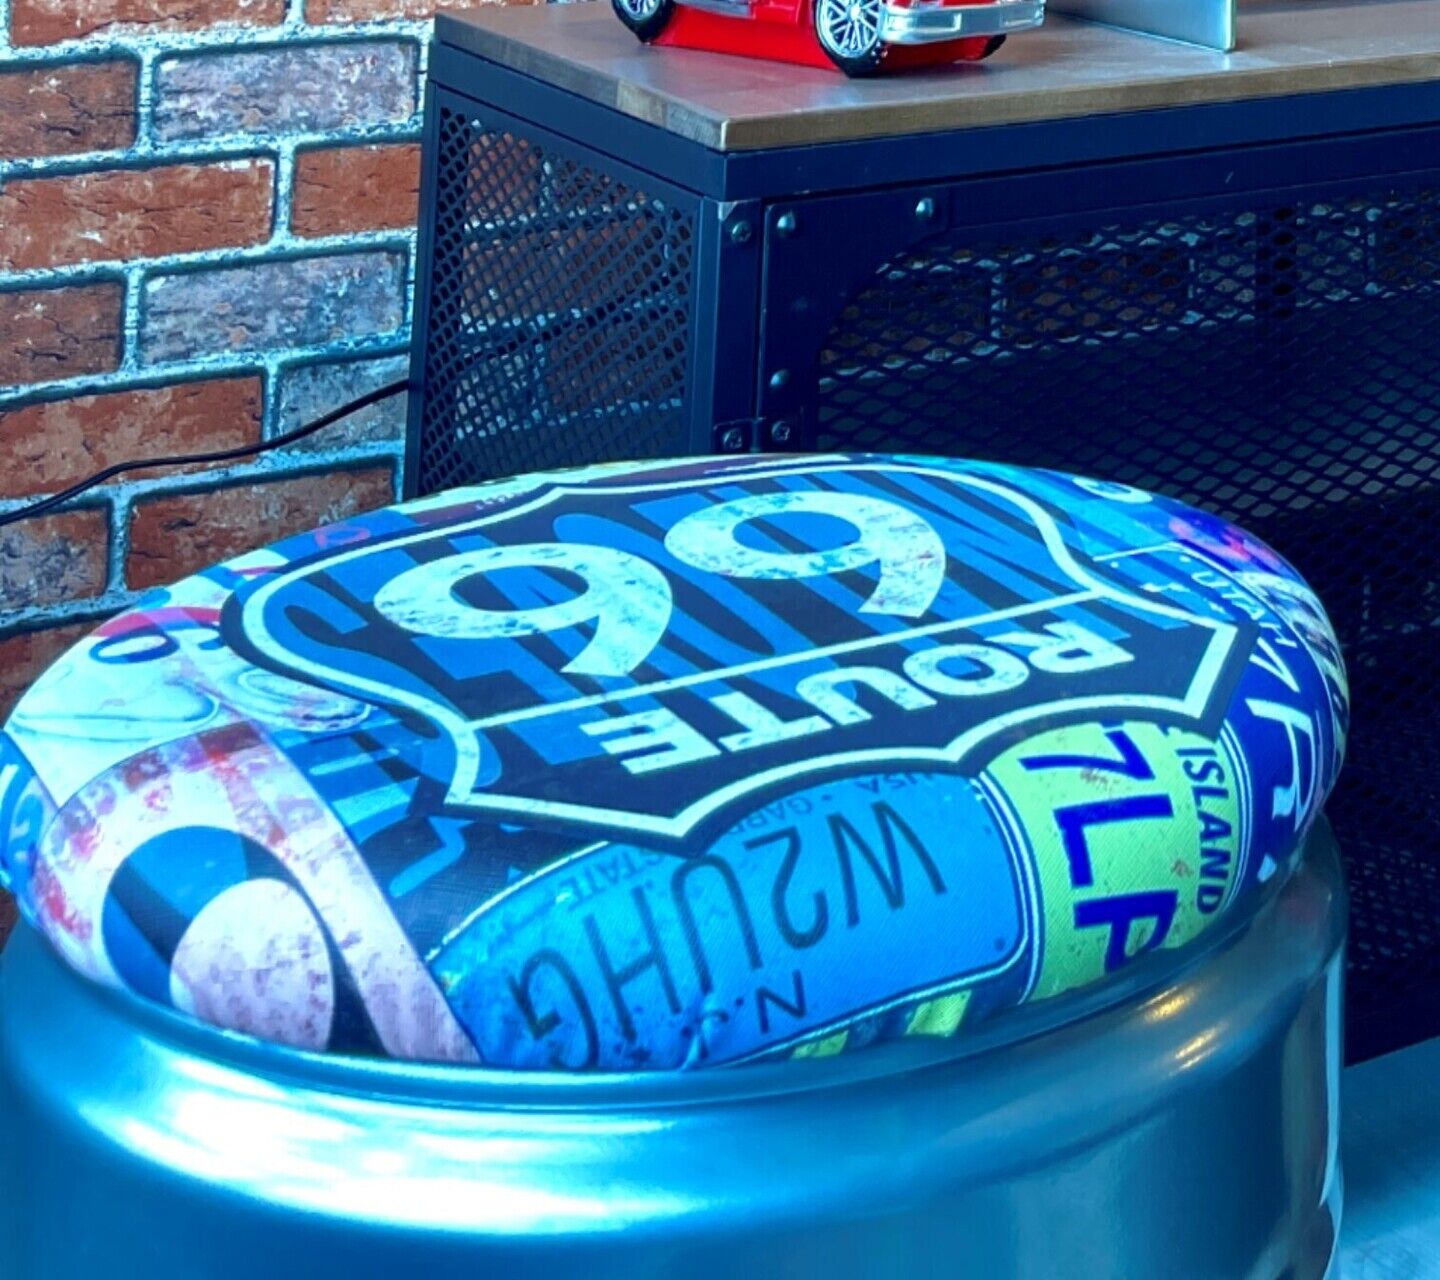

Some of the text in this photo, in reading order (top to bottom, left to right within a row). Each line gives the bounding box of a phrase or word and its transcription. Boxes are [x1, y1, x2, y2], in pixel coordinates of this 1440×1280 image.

[373, 489, 948, 677] 66
[583, 620, 1135, 777] ROUTE
[1175, 747, 1234, 916] ISLAND
